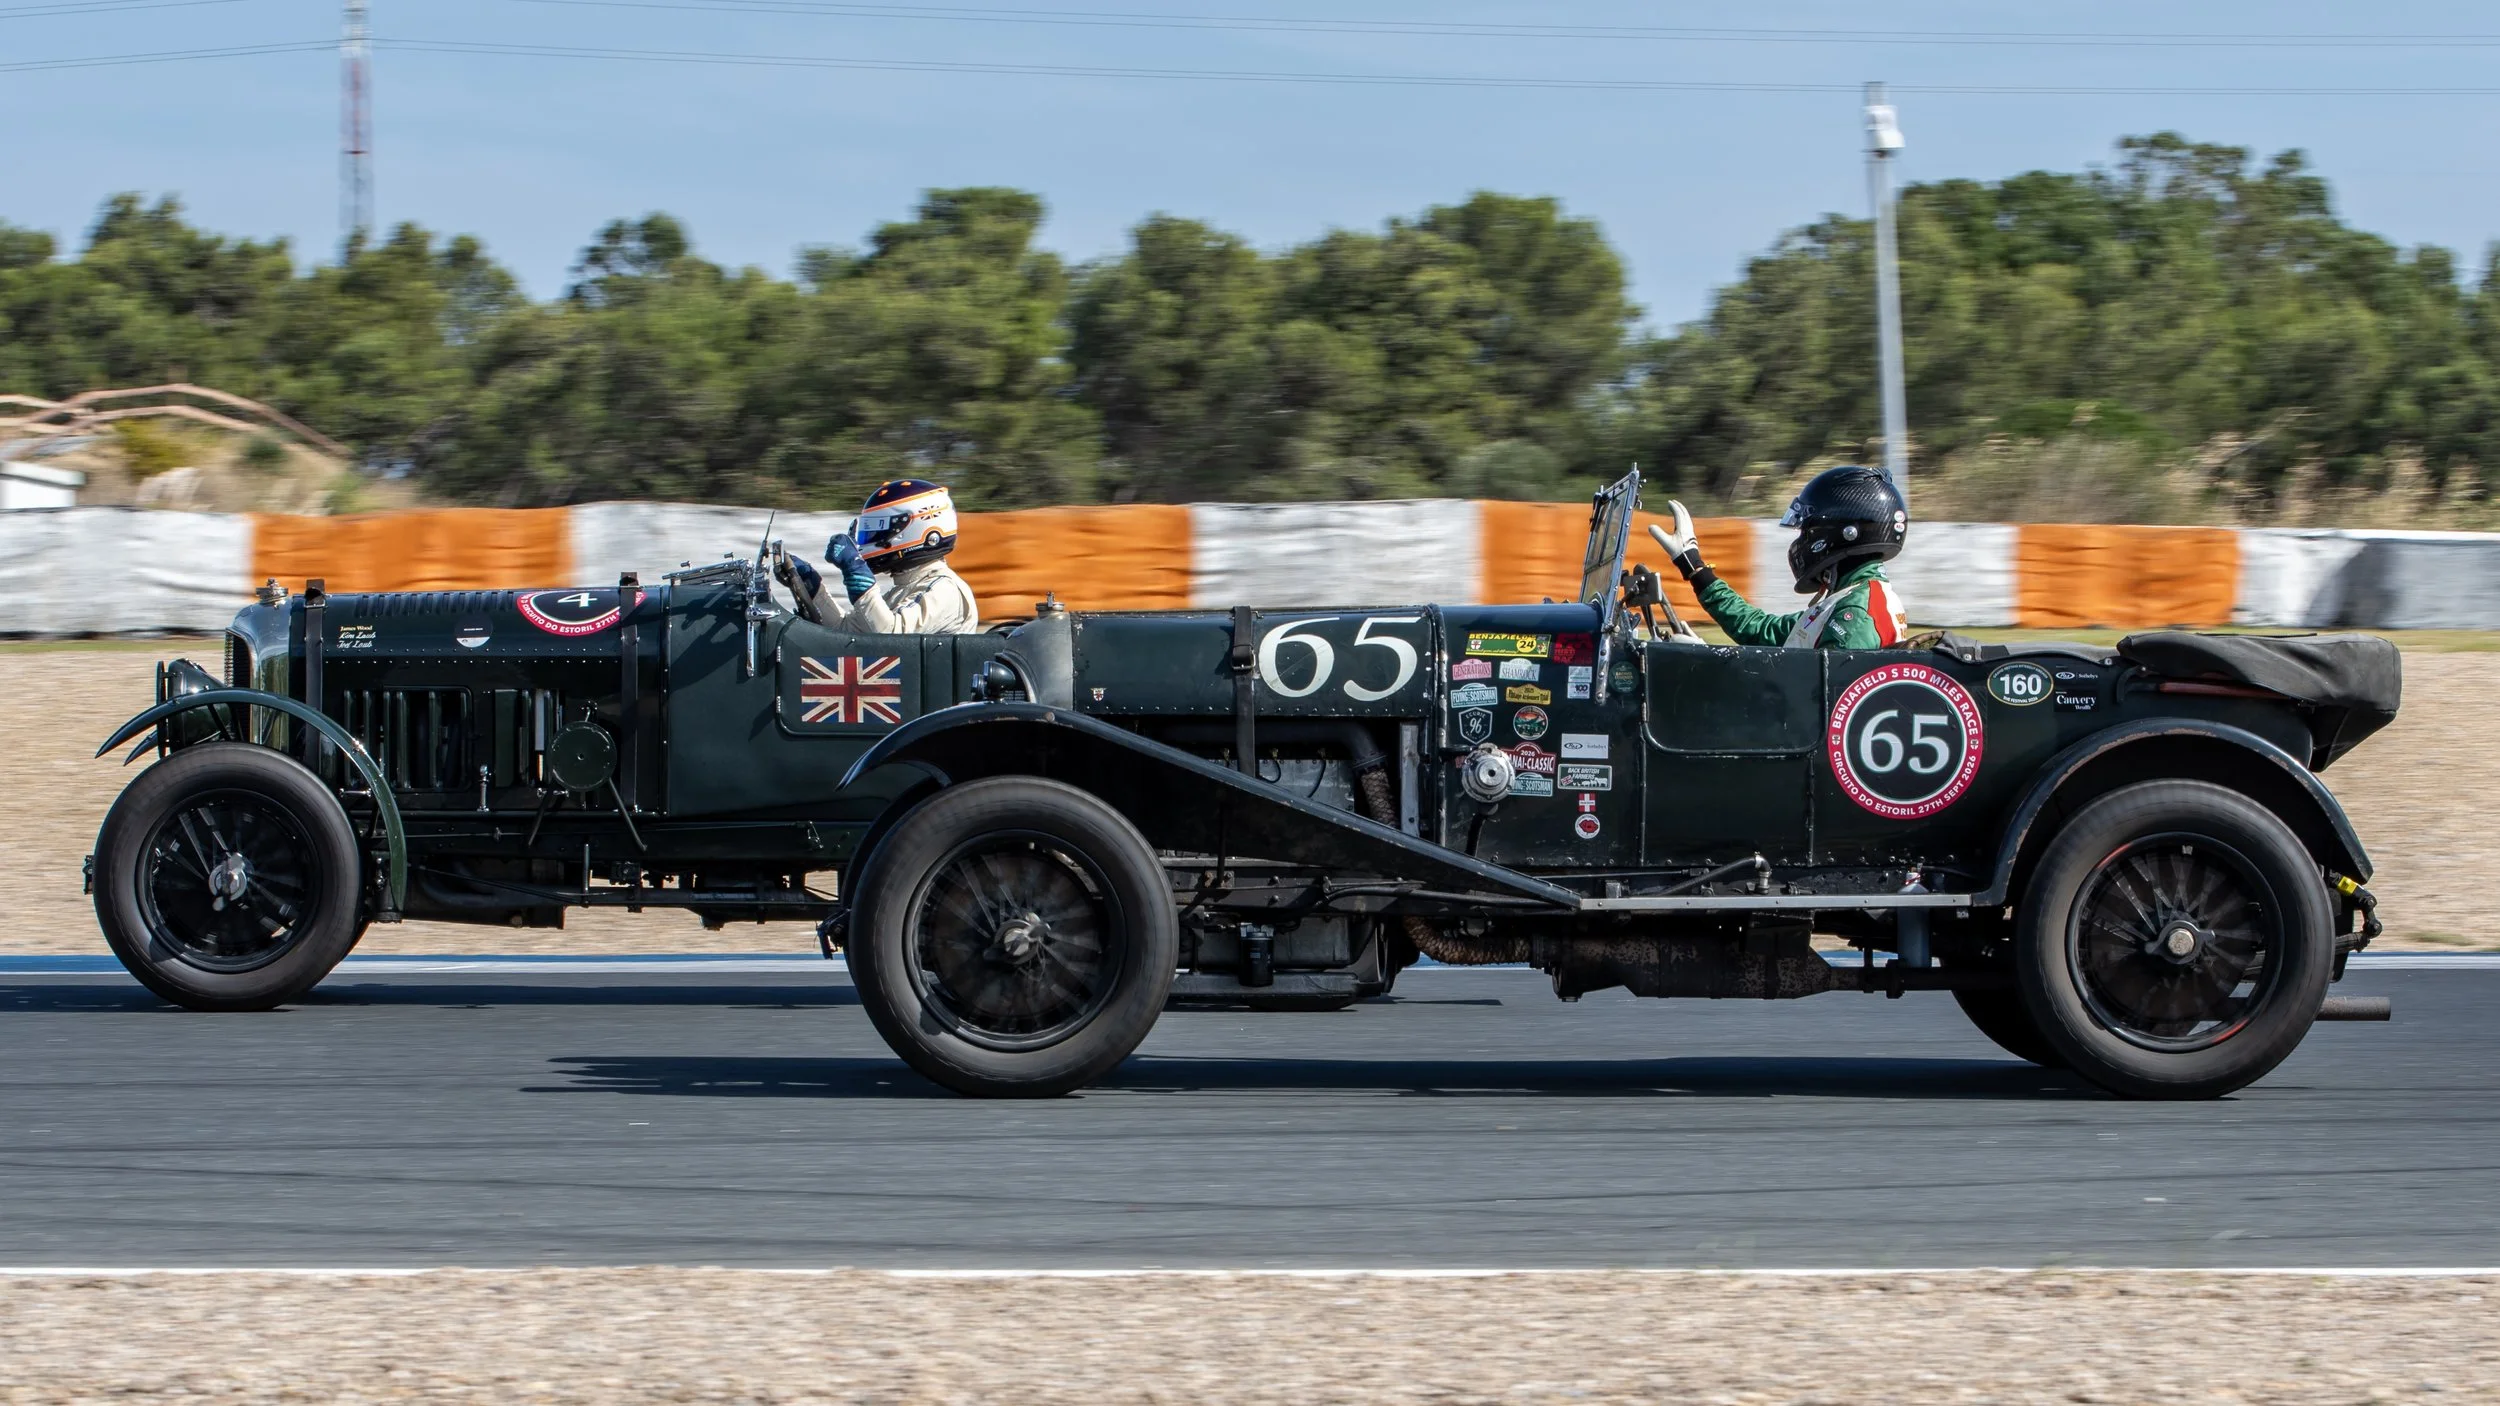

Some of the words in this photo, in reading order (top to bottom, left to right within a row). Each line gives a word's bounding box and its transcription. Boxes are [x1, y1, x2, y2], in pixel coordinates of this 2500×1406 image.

[557, 592, 598, 608] 4
[545, 623, 558, 631] DO
[560, 625, 594, 634] ESTORIL
[595, 615, 617, 629] 27TH
[1519, 640, 1535, 649] 24
[1258, 616, 1421, 702] 65
[1453, 663, 1491, 678] GENERATIONS
[1502, 667, 1537, 681] SHAMROCK
[1999, 673, 2042, 695] 160
[1832, 671, 1888, 729] BENJAFIELD
[1891, 668, 1899, 678] S
[1903, 667, 1927, 680] 500
[1929, 674, 1963, 703] MILES
[1959, 702, 1979, 736] RACE
[2056, 694, 2097, 706] Cauvery
[1465, 711, 1486, 719] ECURIE
[1469, 717, 1483, 734] 96
[1859, 709, 1951, 774] 65
[1520, 749, 1536, 757] 2026
[1832, 751, 1860, 795] CIRCUITO
[1858, 792, 1873, 807] DO
[1875, 802, 1916, 816] ESTORIL
[1918, 799, 1944, 814] 27TH
[1943, 780, 1963, 802] SEPT
[1960, 755, 1977, 781] 2026
